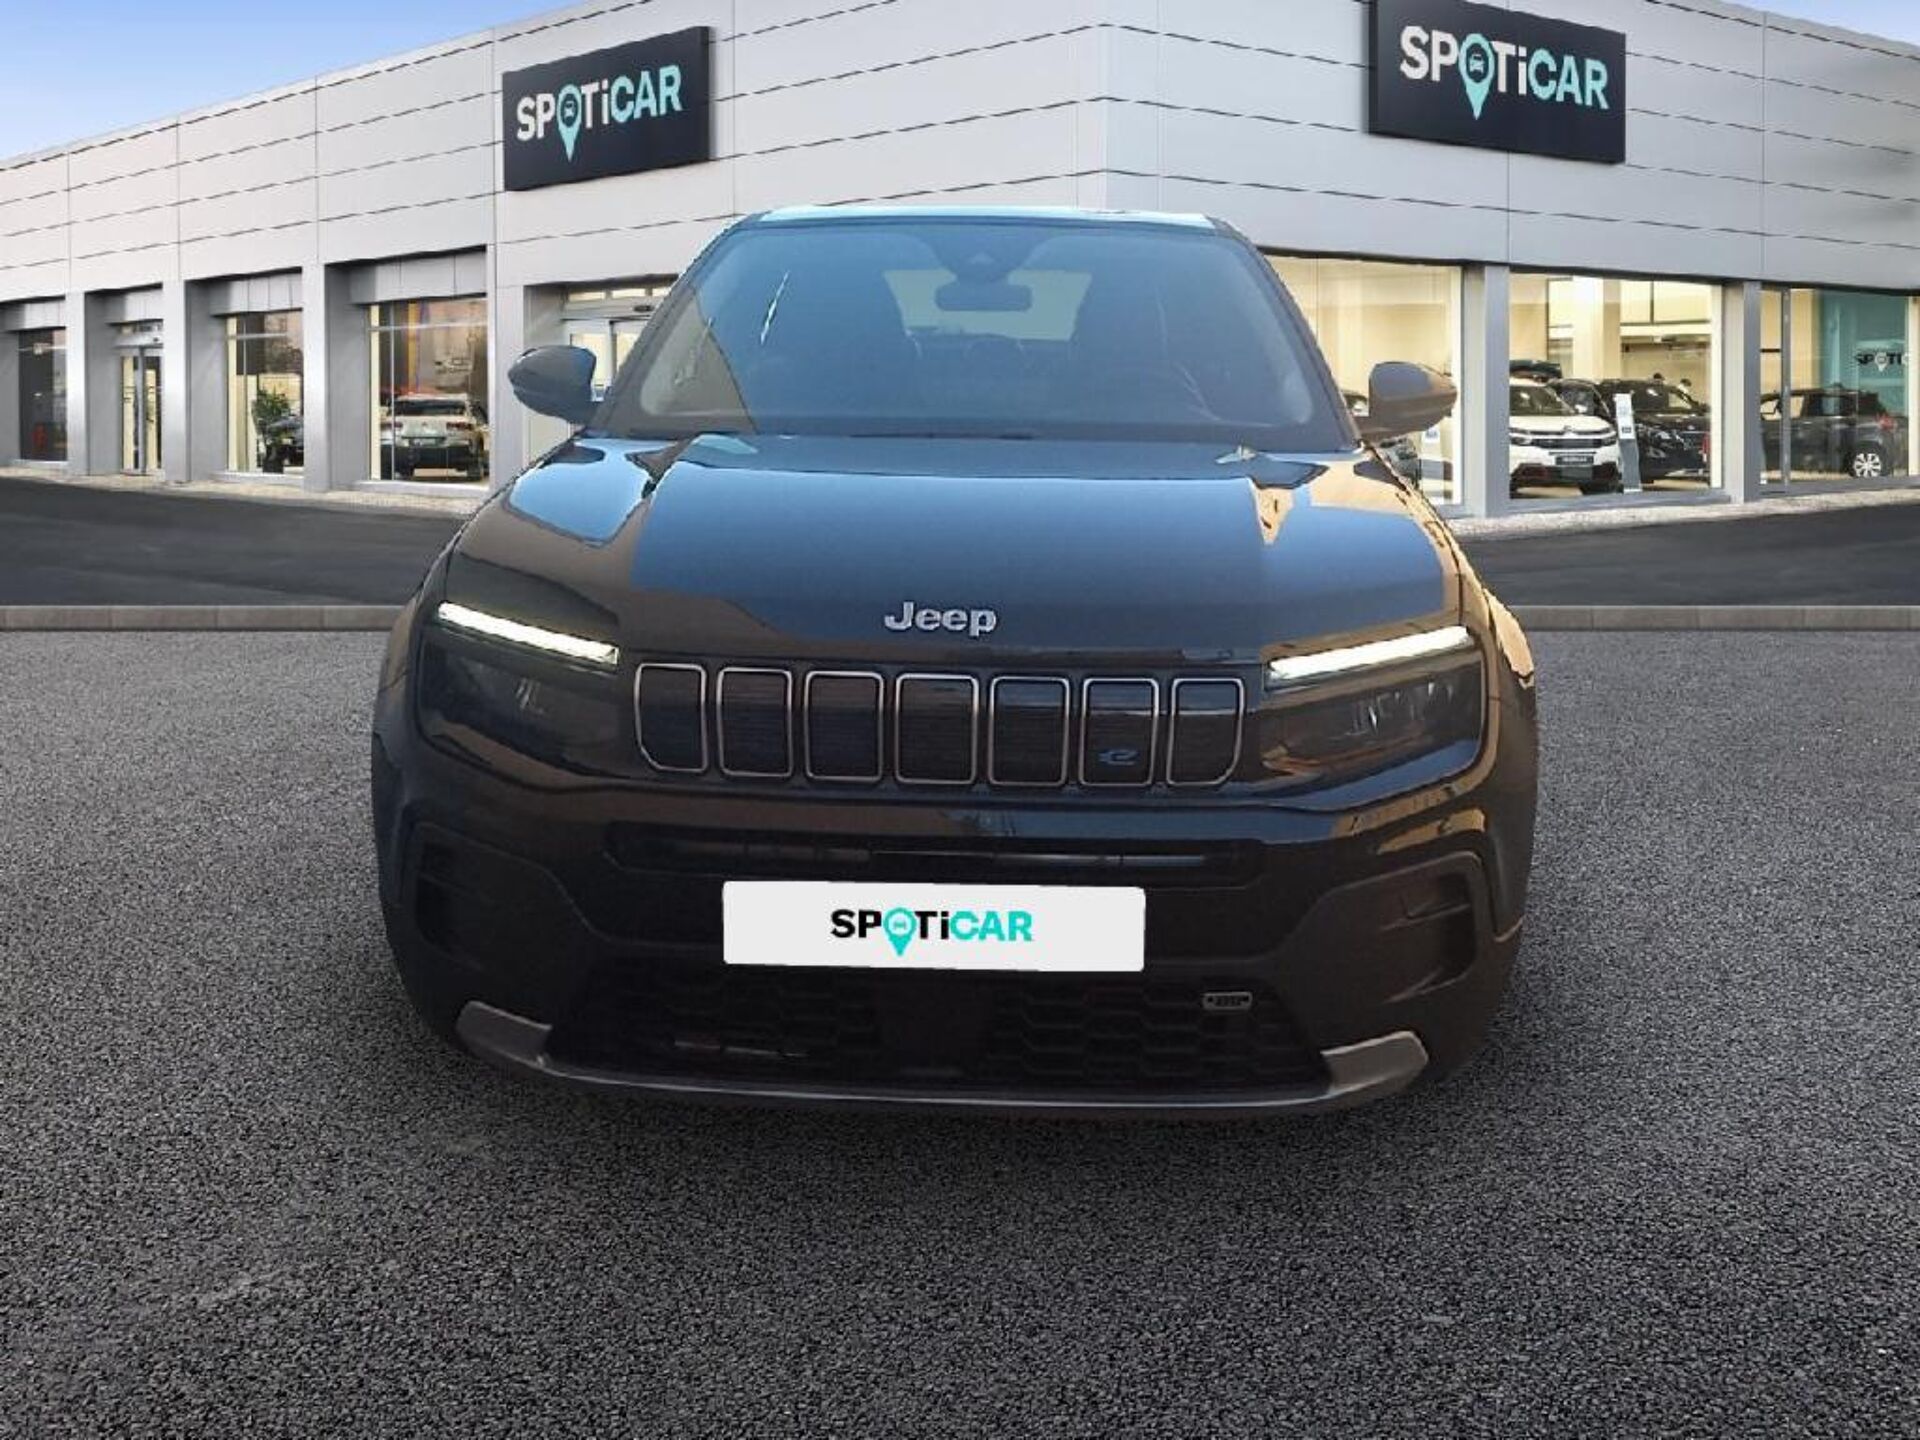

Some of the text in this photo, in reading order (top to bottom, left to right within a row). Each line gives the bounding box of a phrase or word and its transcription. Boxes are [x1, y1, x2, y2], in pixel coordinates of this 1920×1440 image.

[1400, 25, 1609, 120] SPOTiCAR
[516, 65, 683, 162] SPOTiCAR
[884, 601, 997, 637] Jeep
[830, 907, 1033, 956] SPOTiCAR
